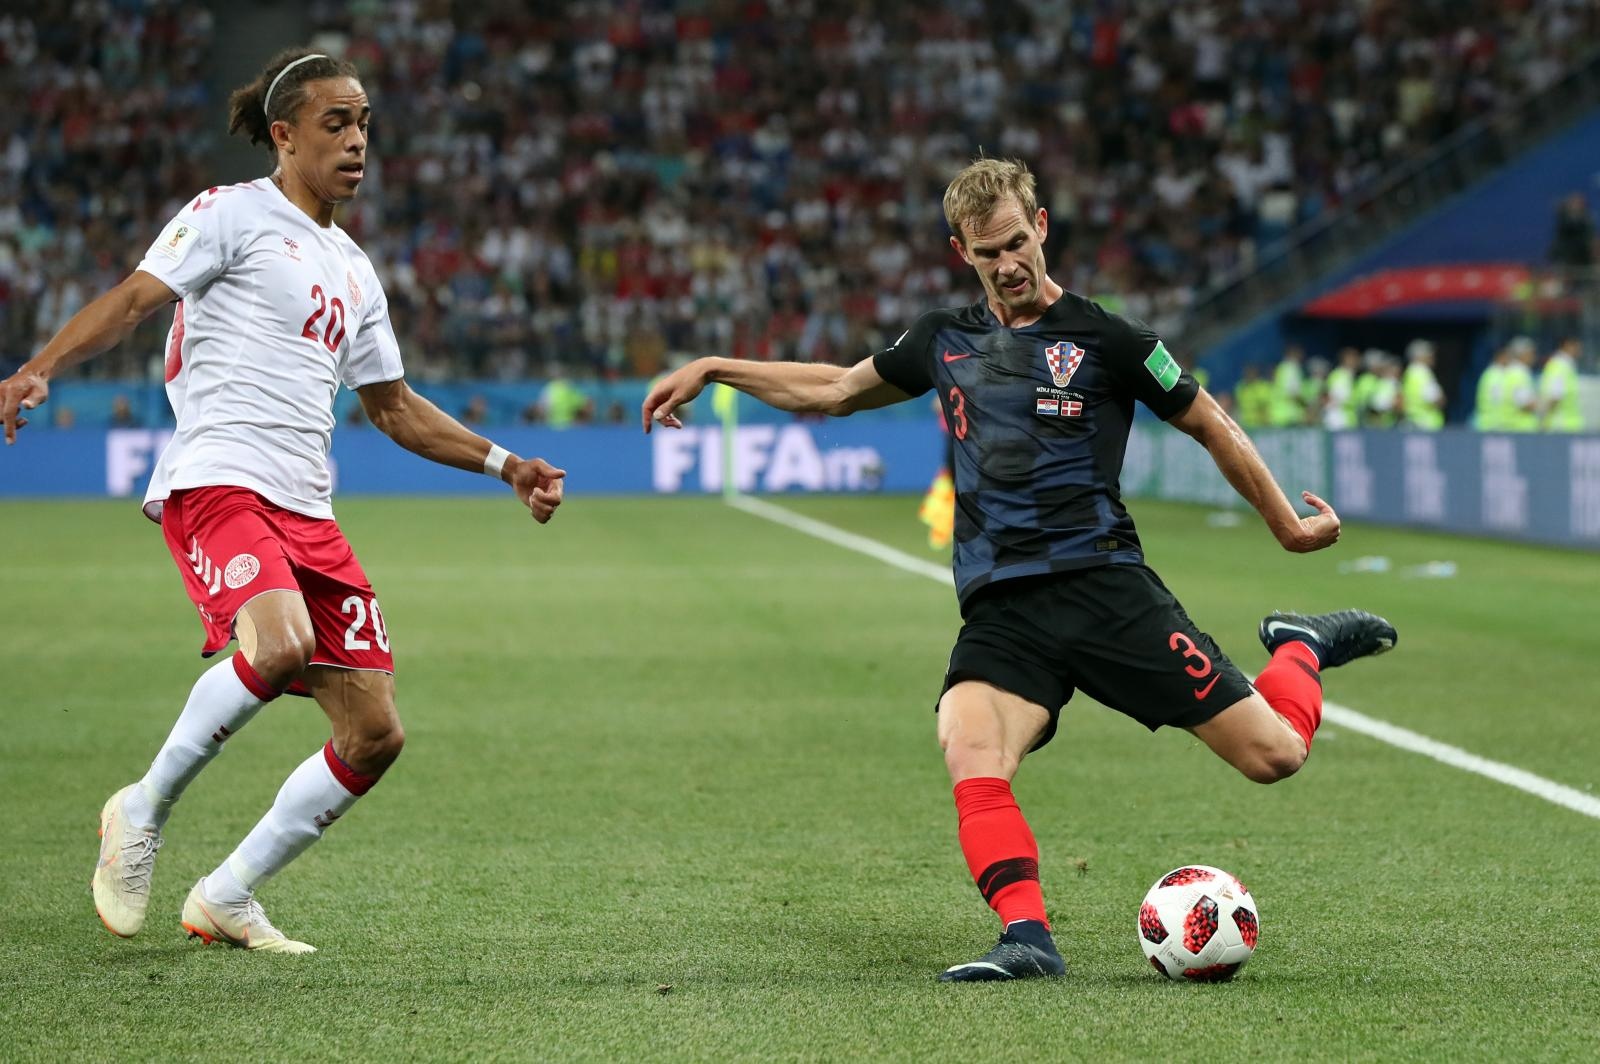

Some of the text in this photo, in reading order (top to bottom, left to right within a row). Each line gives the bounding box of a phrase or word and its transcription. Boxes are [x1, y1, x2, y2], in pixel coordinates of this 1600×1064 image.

[301, 284, 346, 353] 20
[949, 386, 968, 440] 3
[341, 595, 390, 654] 20
[1169, 631, 1212, 679] 3
